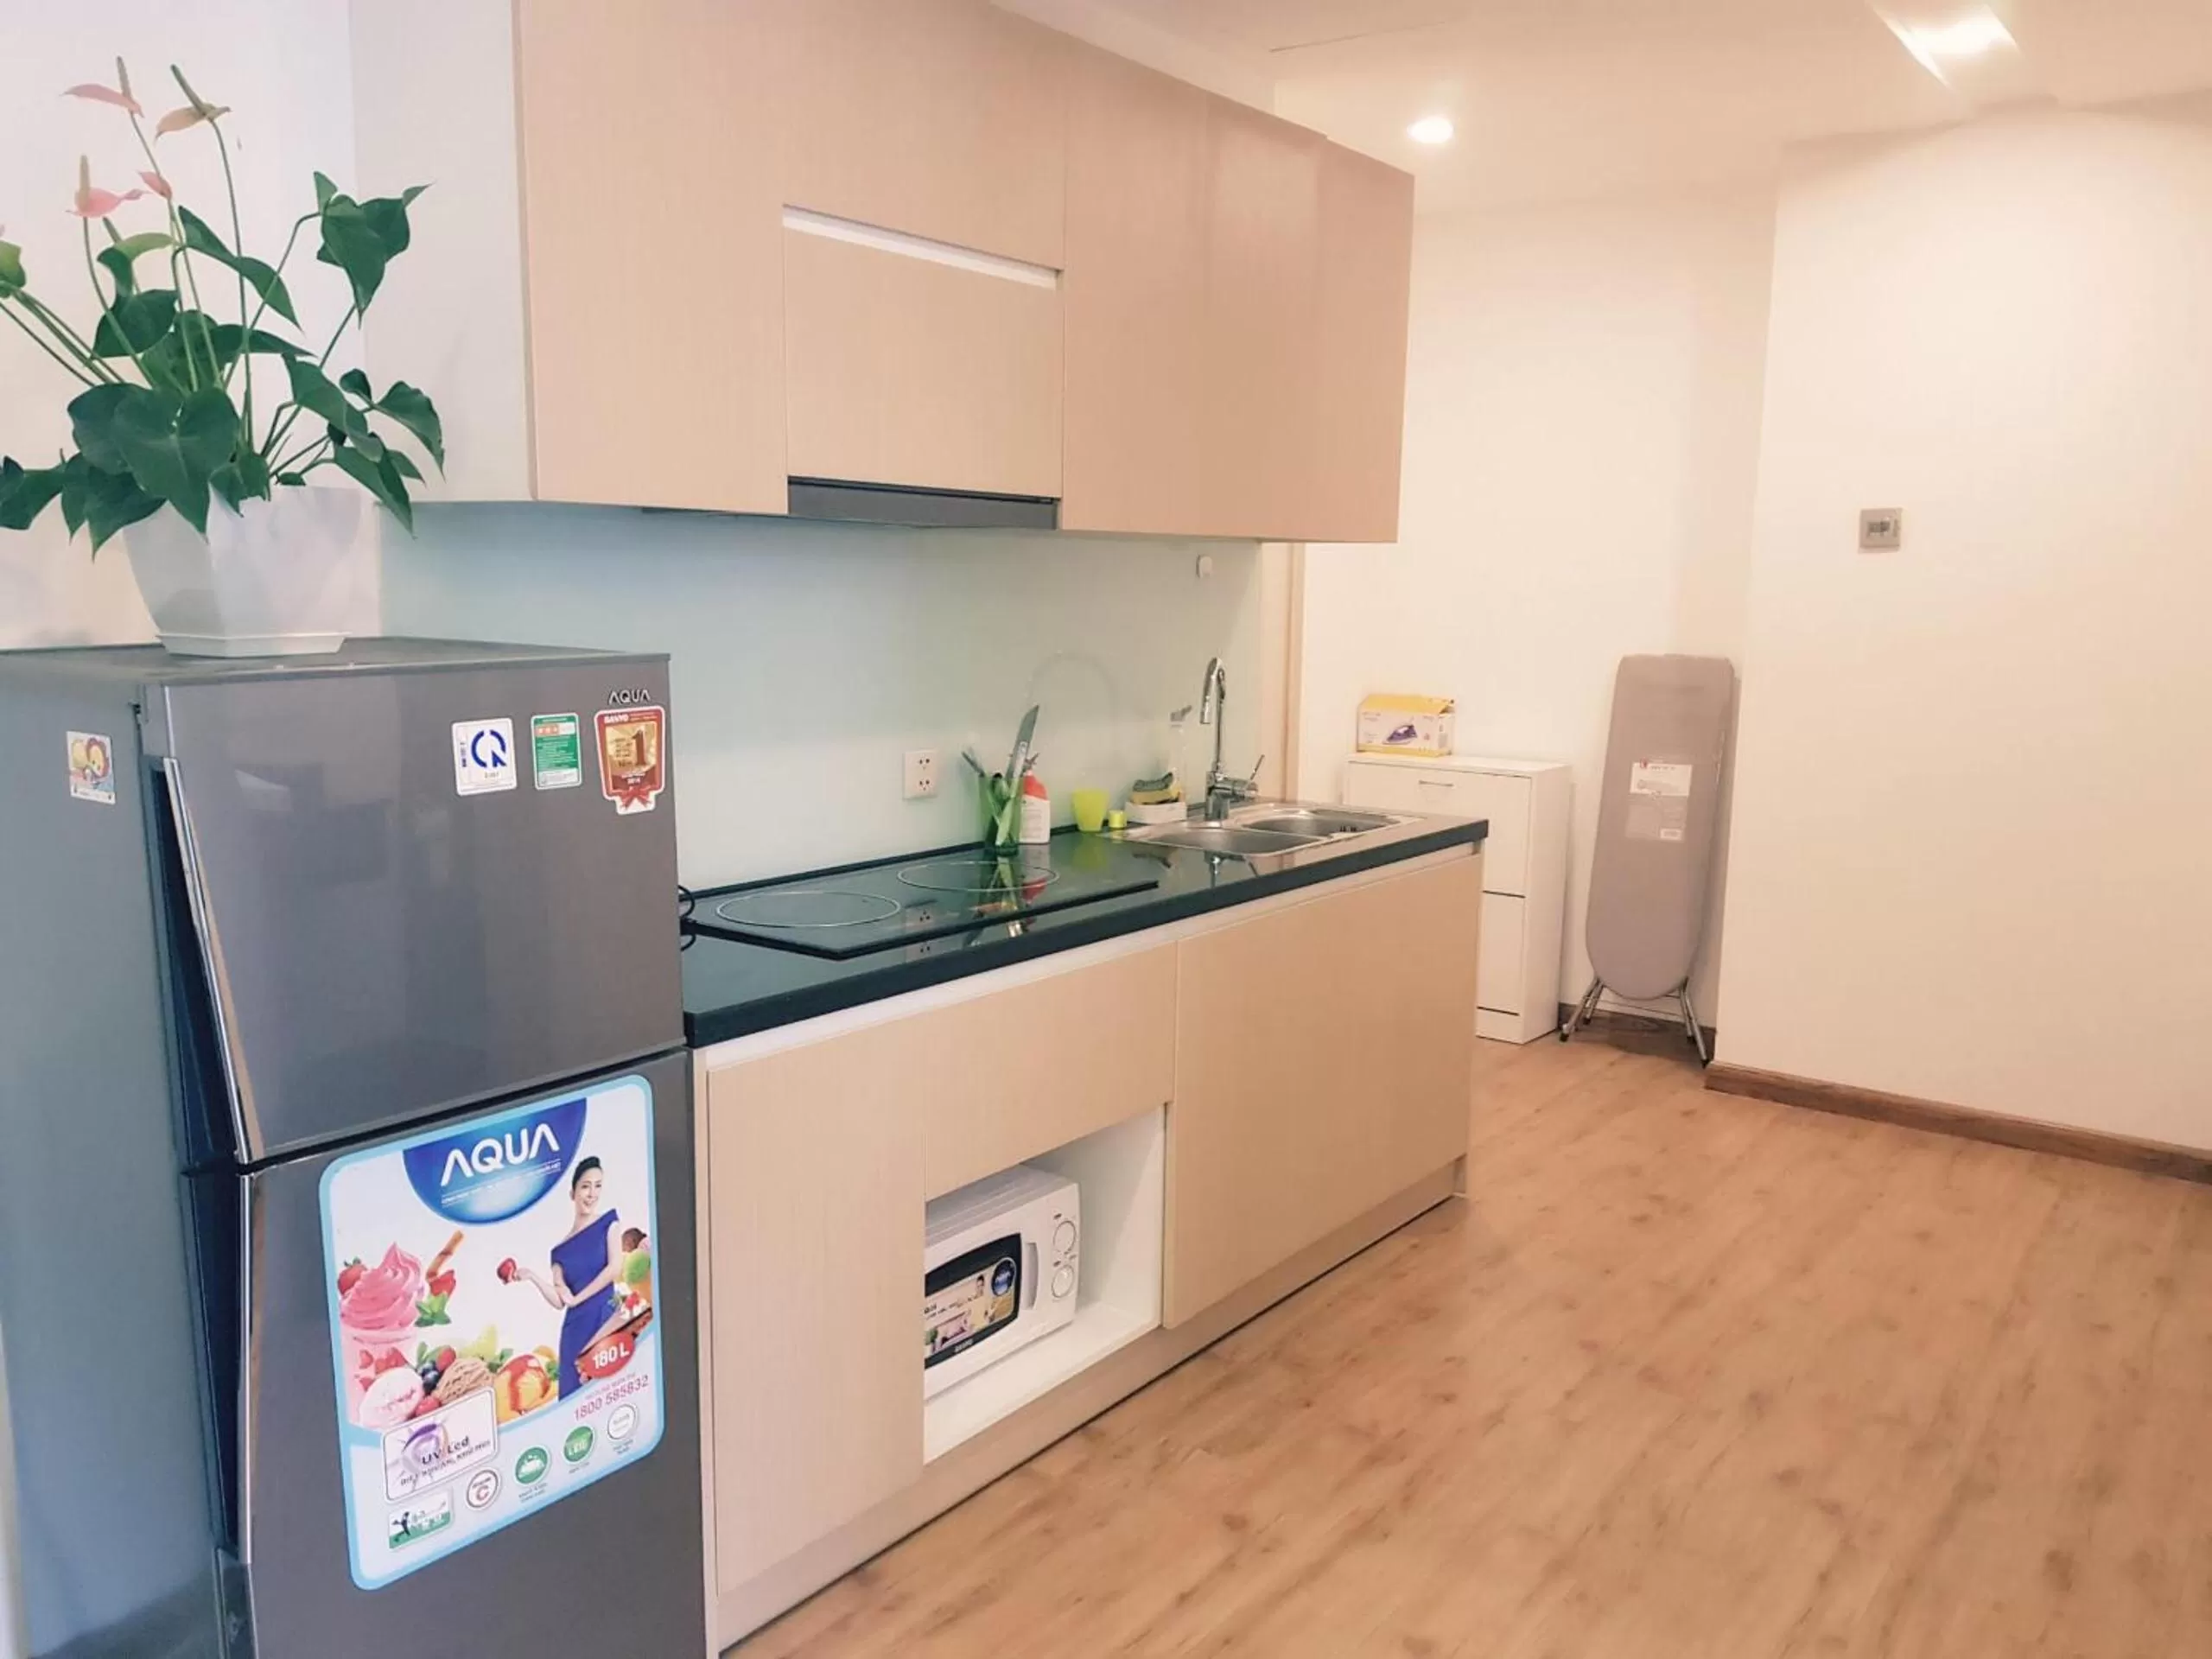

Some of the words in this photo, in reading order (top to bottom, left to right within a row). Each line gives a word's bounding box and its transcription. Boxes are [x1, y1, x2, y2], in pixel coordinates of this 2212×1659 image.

[608, 689, 651, 705] AQUA
[441, 1122, 561, 1187] AQUA
[593, 1344, 619, 1370] 180
[574, 1396, 603, 1421] 1800
[605, 1374, 649, 1405] 585832
